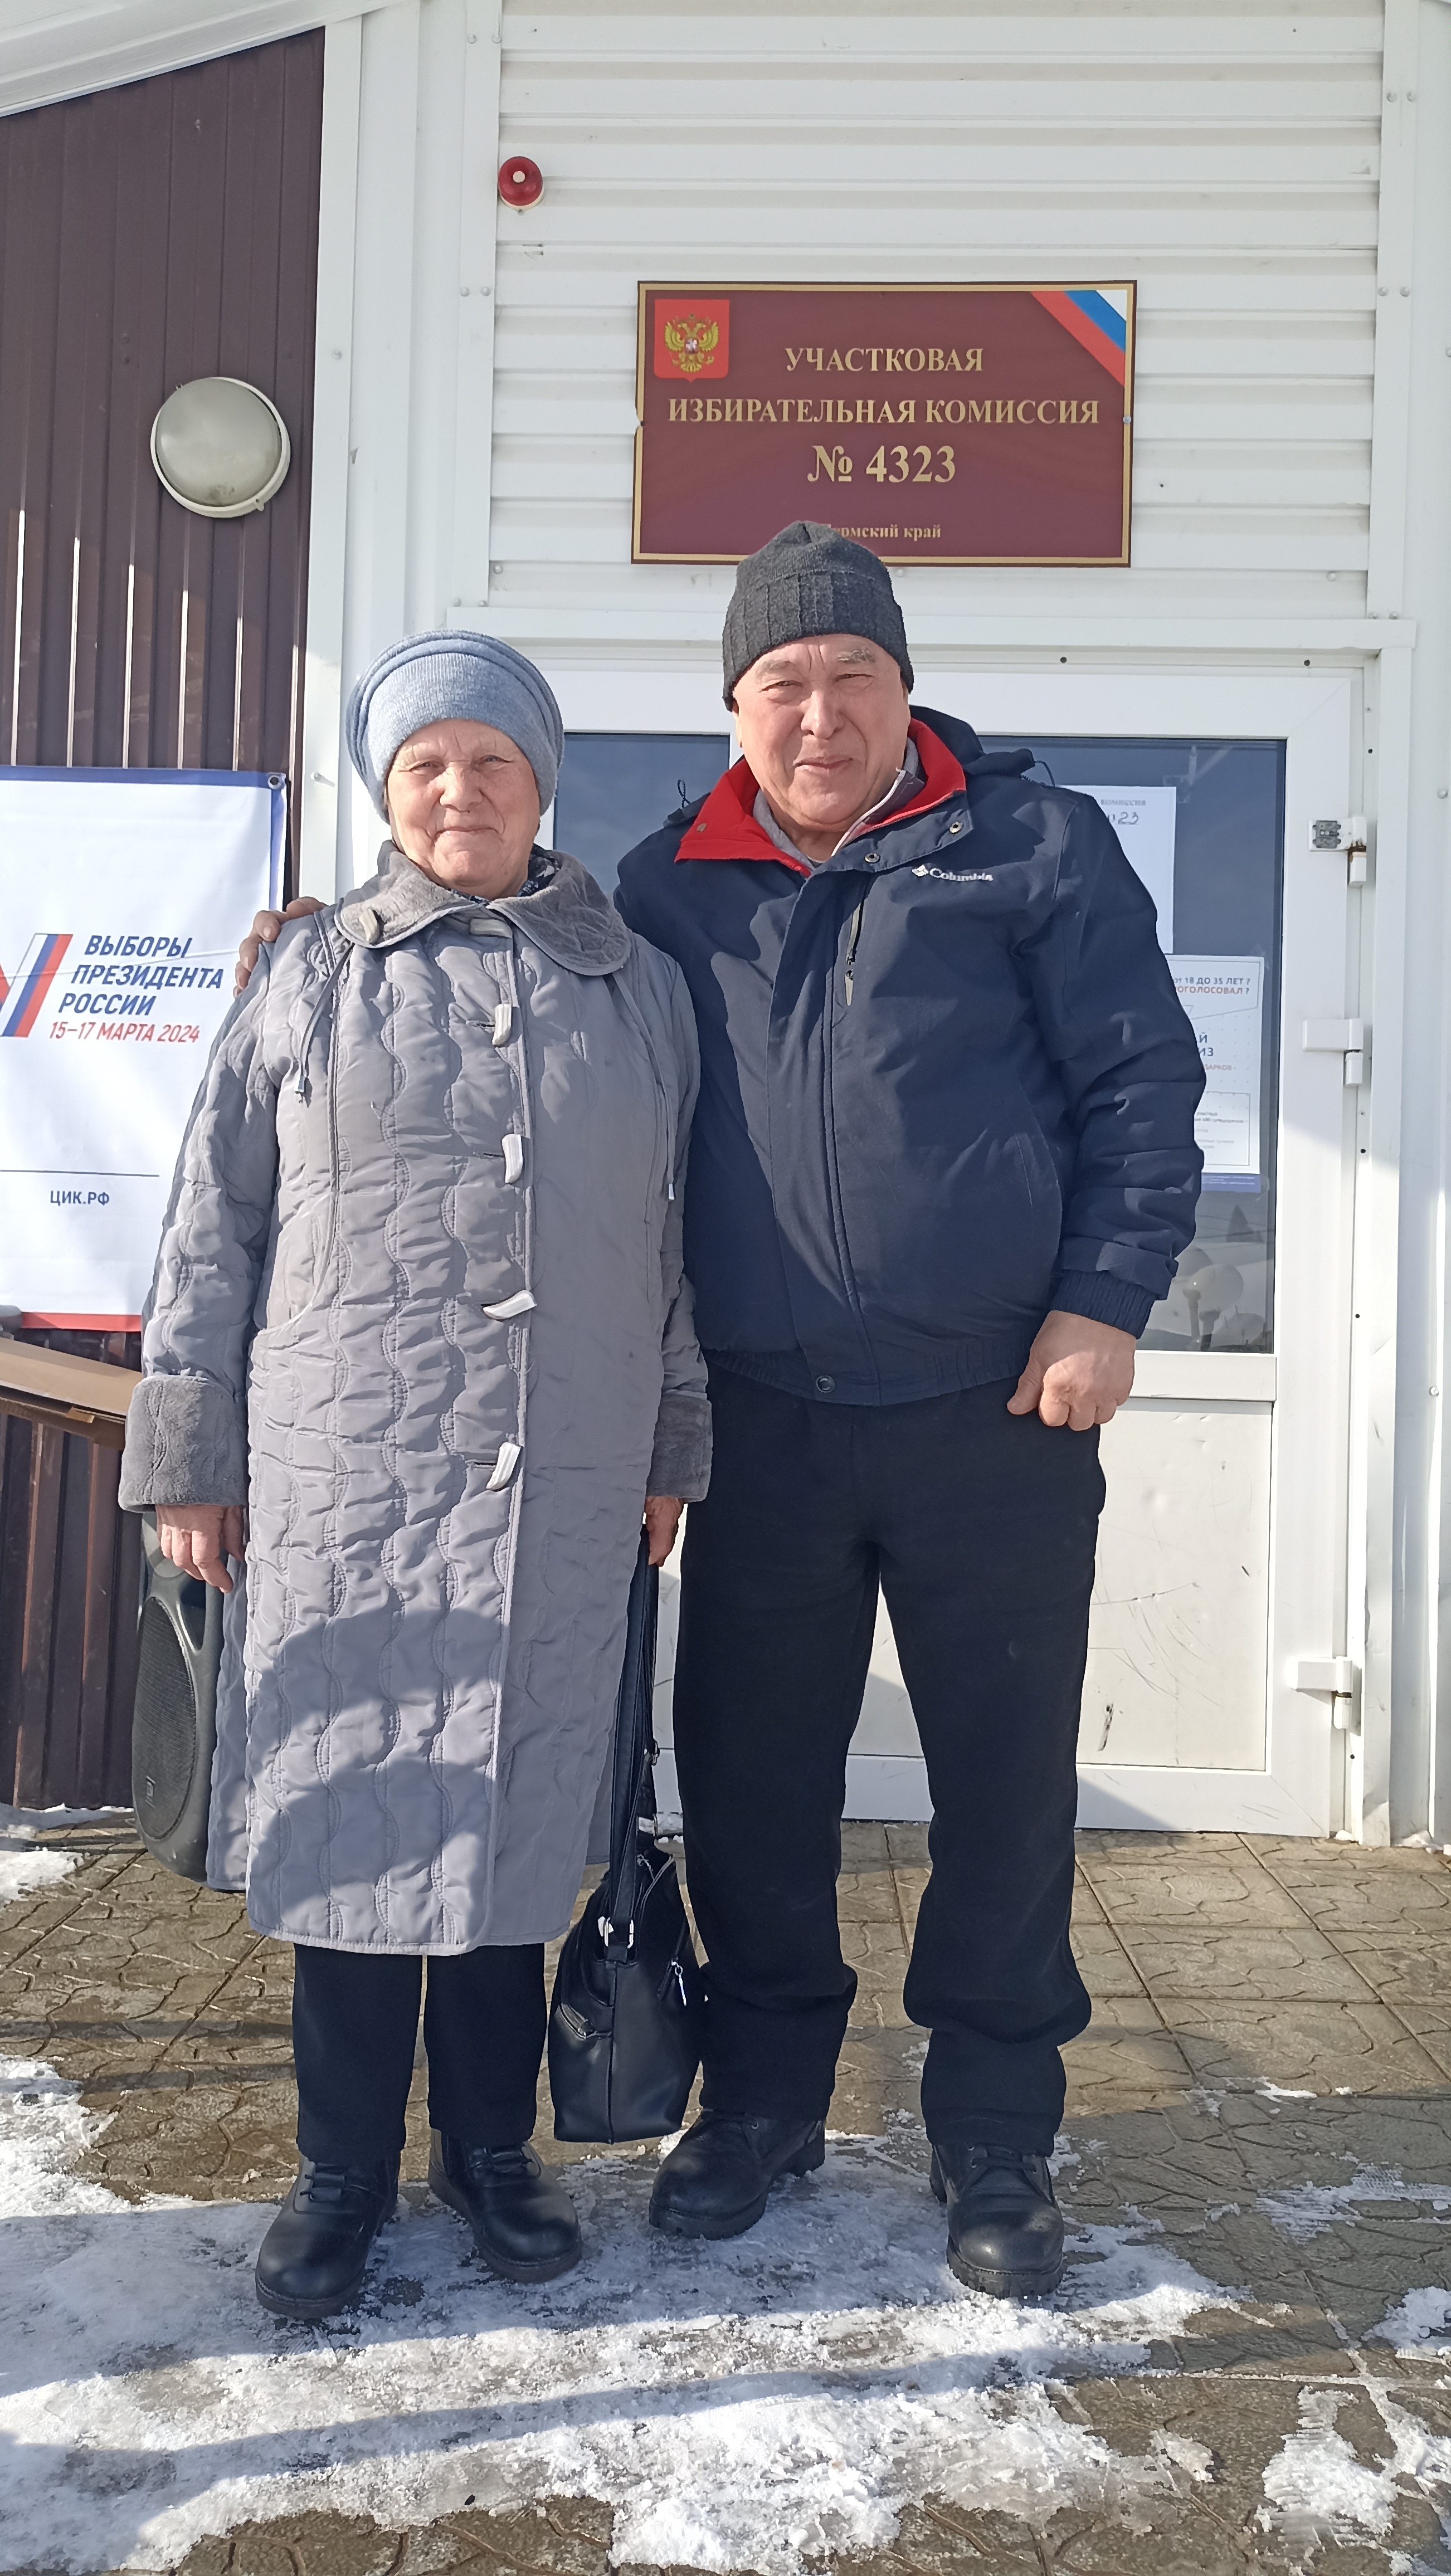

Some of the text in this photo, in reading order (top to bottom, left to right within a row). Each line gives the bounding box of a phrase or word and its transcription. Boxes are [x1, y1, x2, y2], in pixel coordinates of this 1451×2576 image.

[785, 348, 983, 372] УЧАСТКОВАЯ
[668, 398, 1099, 425] ИЗБИРАТЕЛЬНАЯ КОМИССИЯ
[807, 446, 956, 482] № 4323
[824, 524, 941, 541] рмский край
[930, 868, 994, 881] Columbia
[84, 935, 193, 958] ВЫБОРЫ
[71, 964, 223, 990] ПРЕЗИДЕНТА
[1176, 986, 1243, 994] ОГОЛОСОВАЛ
[58, 993, 157, 1016] РОССИИ
[96, 1023, 155, 1042] МАРТА
[157, 1024, 200, 1043] 2024
[50, 1191, 110, 1206] ЦИК.РФ
